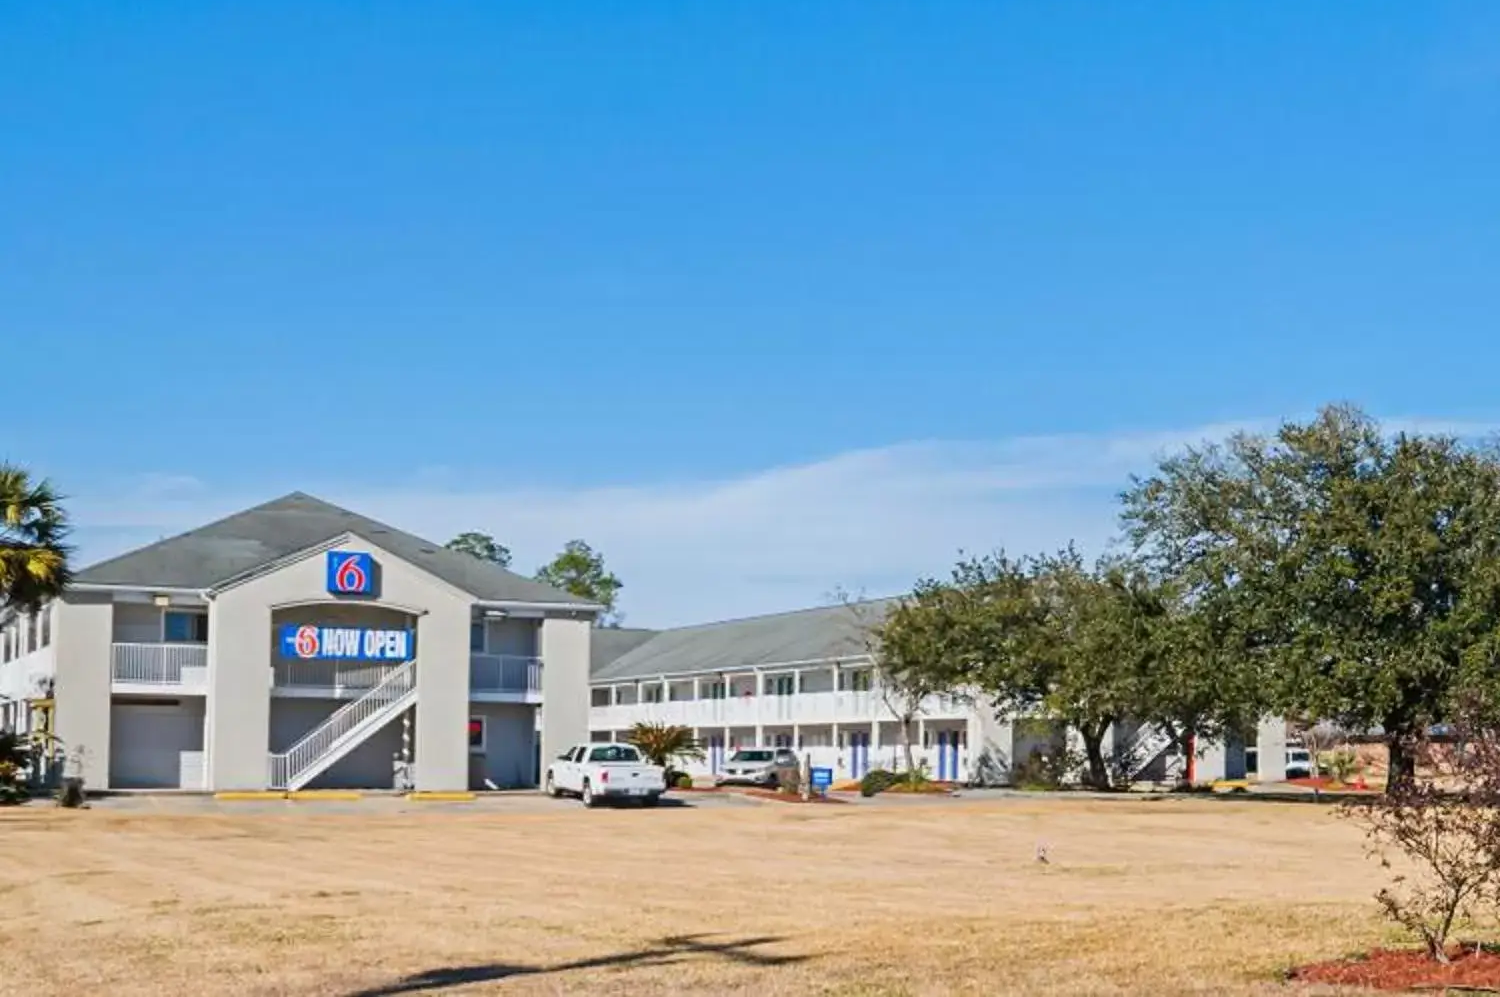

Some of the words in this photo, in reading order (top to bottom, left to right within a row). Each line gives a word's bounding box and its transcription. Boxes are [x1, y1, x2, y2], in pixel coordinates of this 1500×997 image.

[336, 555, 366, 592] 6
[296, 625, 319, 658] 6
[322, 628, 361, 657] NOW
[364, 629, 407, 658] OPEN
